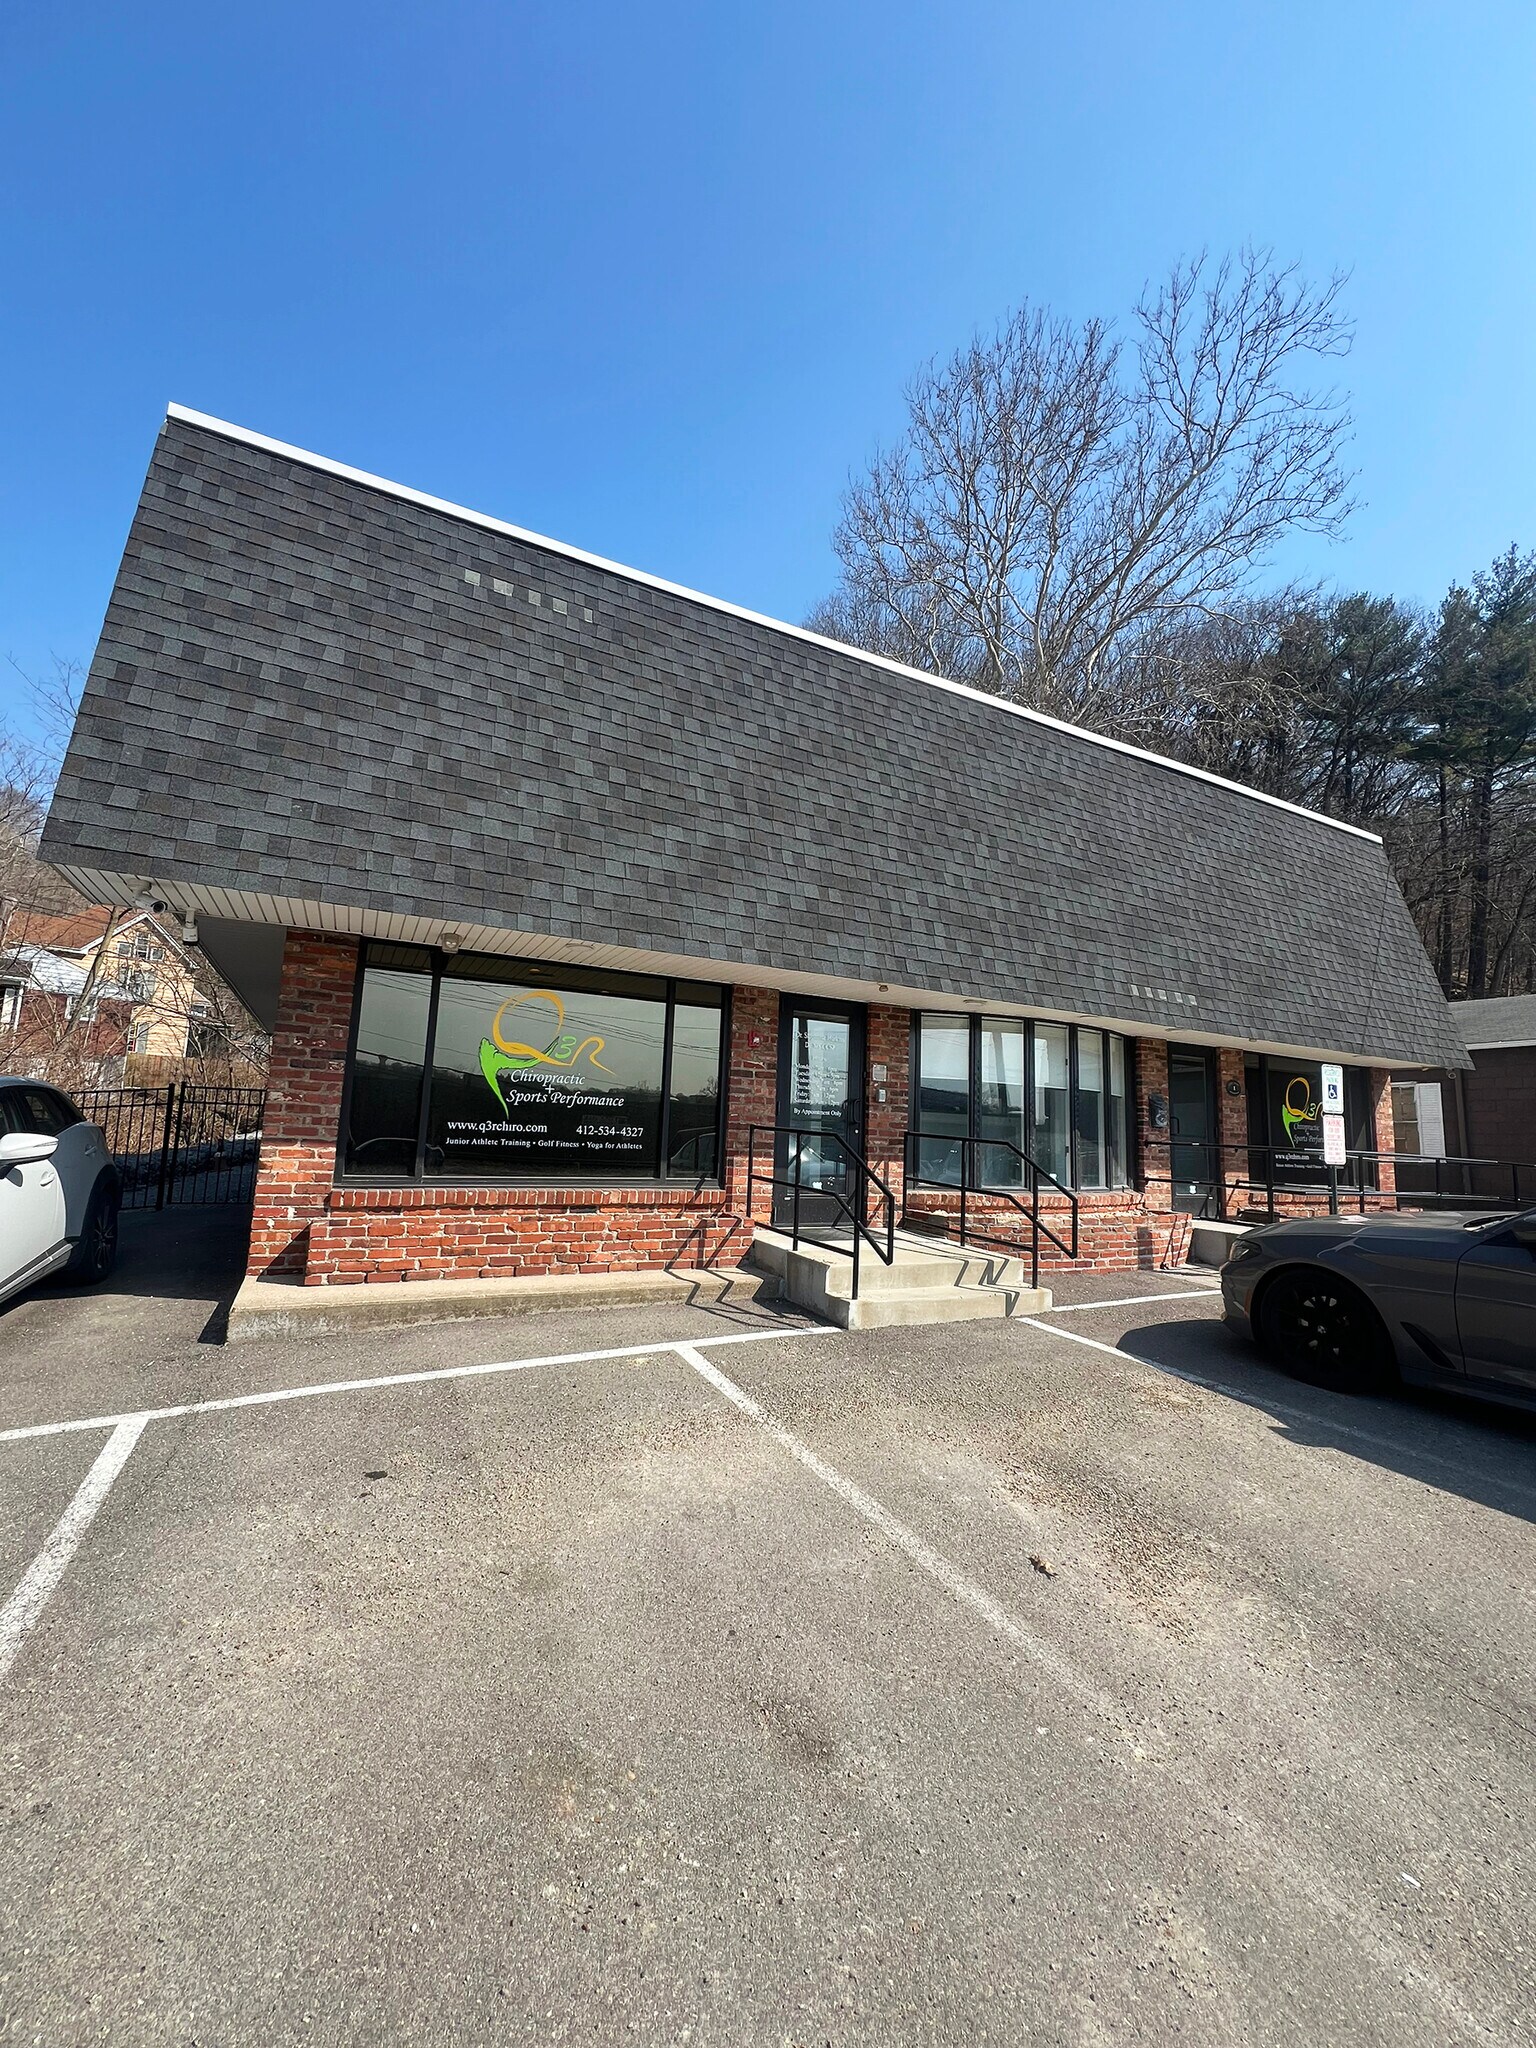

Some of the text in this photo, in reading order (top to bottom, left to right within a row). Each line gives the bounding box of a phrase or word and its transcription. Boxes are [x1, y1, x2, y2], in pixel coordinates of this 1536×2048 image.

[511, 1069, 585, 1086] Chiropractic
[506, 1089, 625, 1108] Sports Performance
[447, 1120, 644, 1137] www.q3rchiro.com 412-534-4327
[446, 1137, 470, 1145] Junior
[471, 1138, 498, 1146] Athlete
[501, 1138, 531, 1148] Training
[587, 1142, 603, 1150] Yoga
